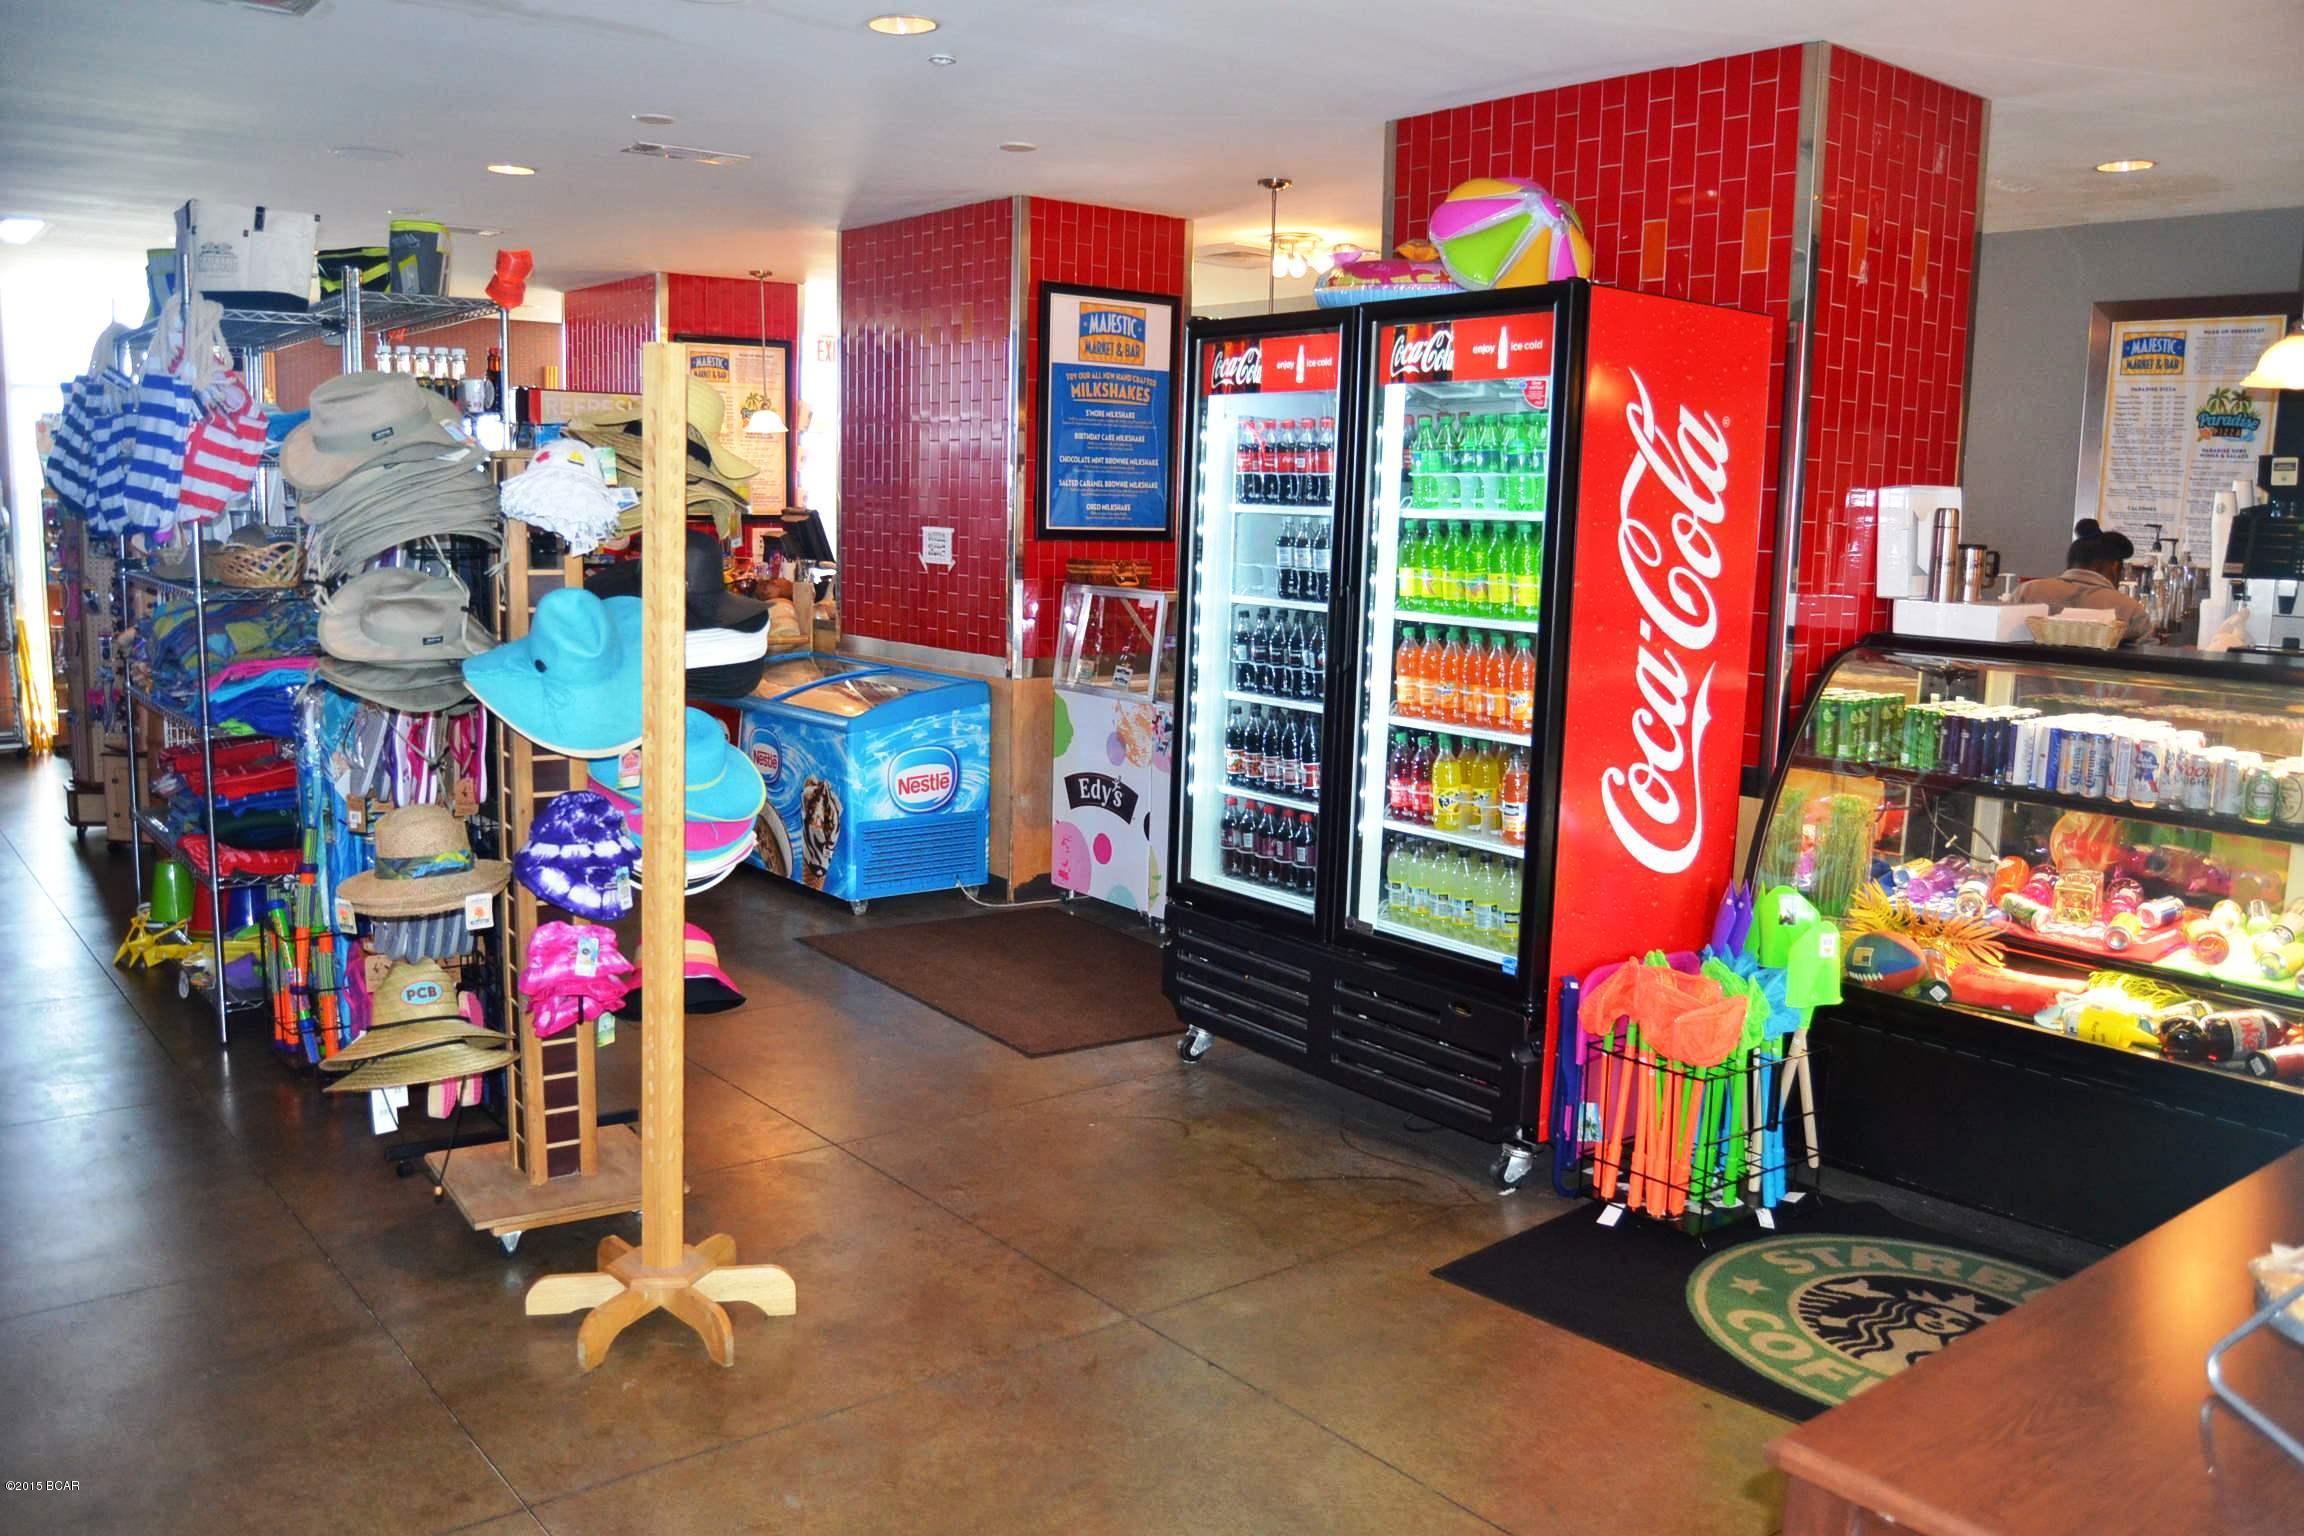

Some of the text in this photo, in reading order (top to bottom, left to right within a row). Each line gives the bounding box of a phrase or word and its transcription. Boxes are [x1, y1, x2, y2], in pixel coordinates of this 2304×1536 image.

[1089, 312, 1137, 338] MAJESTIC
[1116, 343, 1123, 357] &
[1124, 344, 1140, 358] BAR
[1472, 343, 1496, 356] enjoy
[1511, 340, 1543, 351] ice cold
[2131, 337, 2177, 355] MAJESTIC
[1276, 360, 1295, 370] enjoy
[1306, 357, 1333, 368] ice cold
[1071, 382, 1152, 403] MILKSHAKES
[2199, 412, 2259, 429] Paradise
[1074, 432, 1100, 441] BIRTHDAY
[1059, 455, 1090, 464] CHOCOLATE
[1601, 368, 1730, 874] Coca-Cola
[1078, 776, 1123, 808] Edy's
[406, 986, 438, 1001] PCB
[1760, 1246, 2057, 1301] STARB
